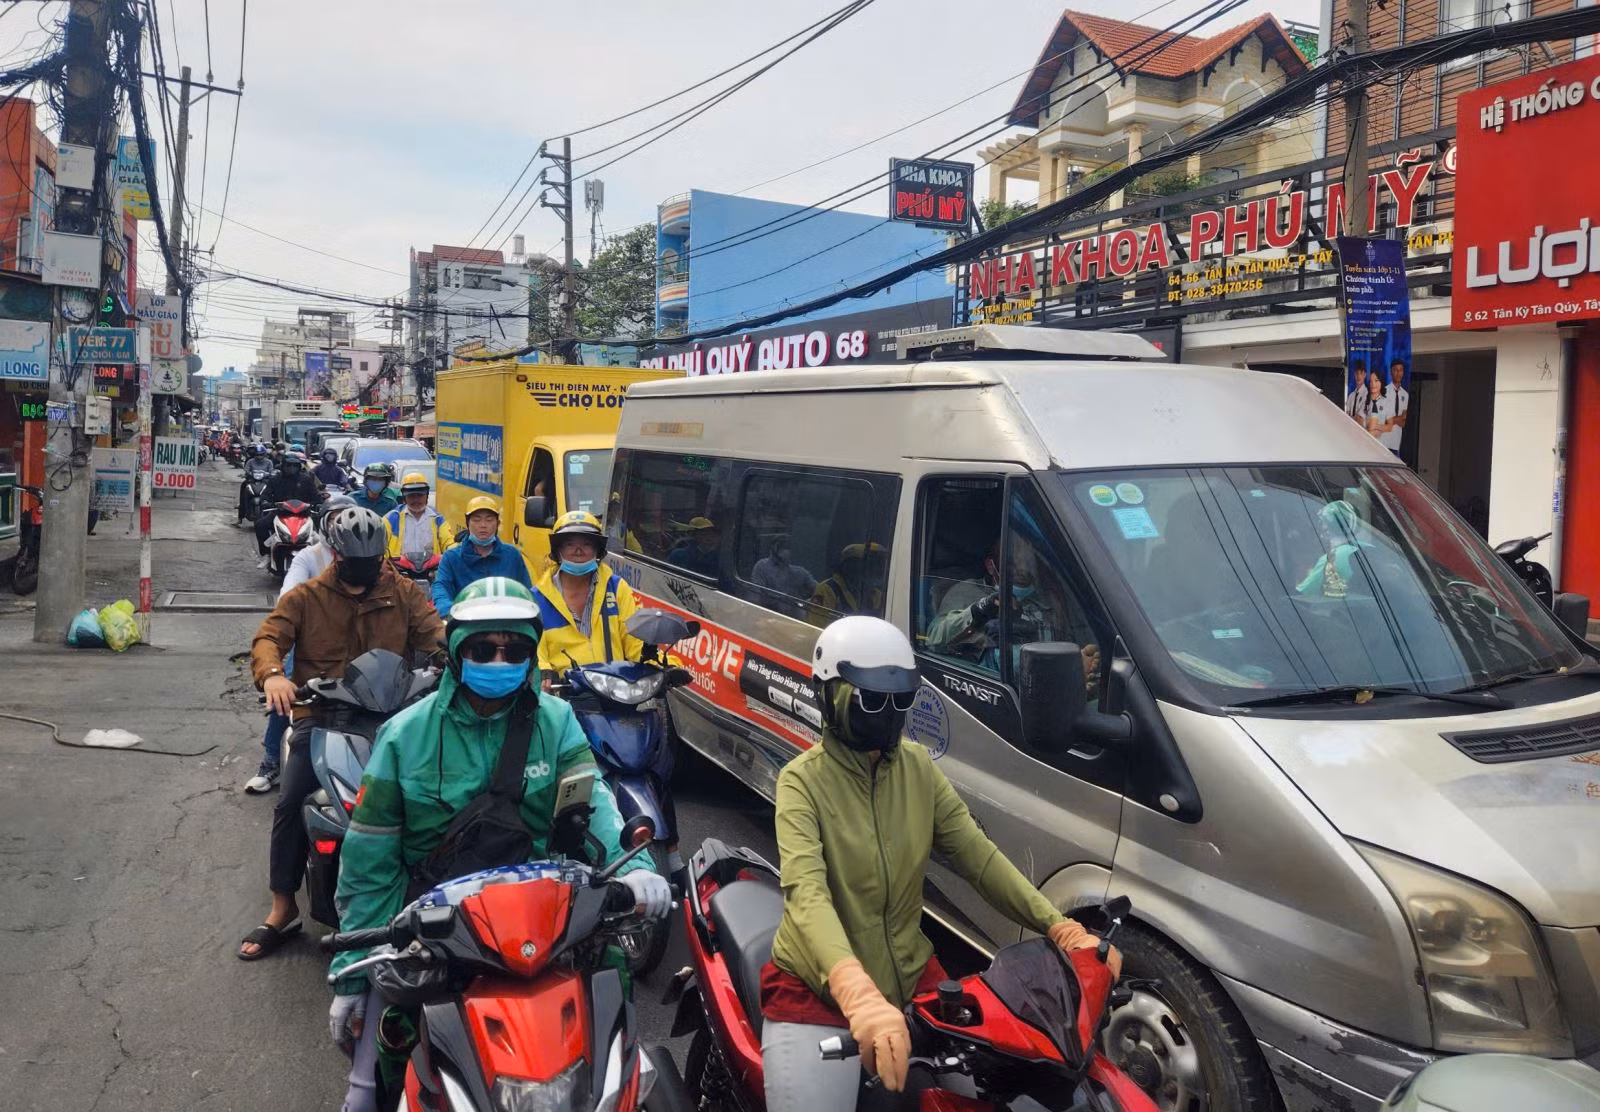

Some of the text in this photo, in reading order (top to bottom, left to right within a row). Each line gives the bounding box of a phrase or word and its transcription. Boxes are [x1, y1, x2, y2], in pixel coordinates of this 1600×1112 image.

[1480, 96, 1504, 132] HỆ
[1510, 77, 1585, 121] THỐNG
[900, 165, 963, 187] NHA KHOA
[896, 187, 966, 221] PHÚ MỸ
[969, 252, 1037, 300] NHA
[1051, 223, 1171, 288] KHOA
[1190, 178, 1305, 264] PHÚ
[1186, 279, 1263, 299] 028.38470256
[1474, 311, 1488, 321] 62
[1493, 308, 1513, 319] Tân
[1530, 304, 1551, 315] Tân
[111, 335, 126, 348] 77
[706, 334, 752, 376] QUÝ
[758, 331, 829, 371] AUTO
[836, 330, 865, 360] 68
[4, 362, 40, 376] LONG
[156, 440, 196, 467] RAU MÁ
[155, 472, 195, 488] 9.000
[771, 670, 784, 684] Giao
[942, 674, 1001, 706] TRANSIT
[523, 760, 551, 779] rab
